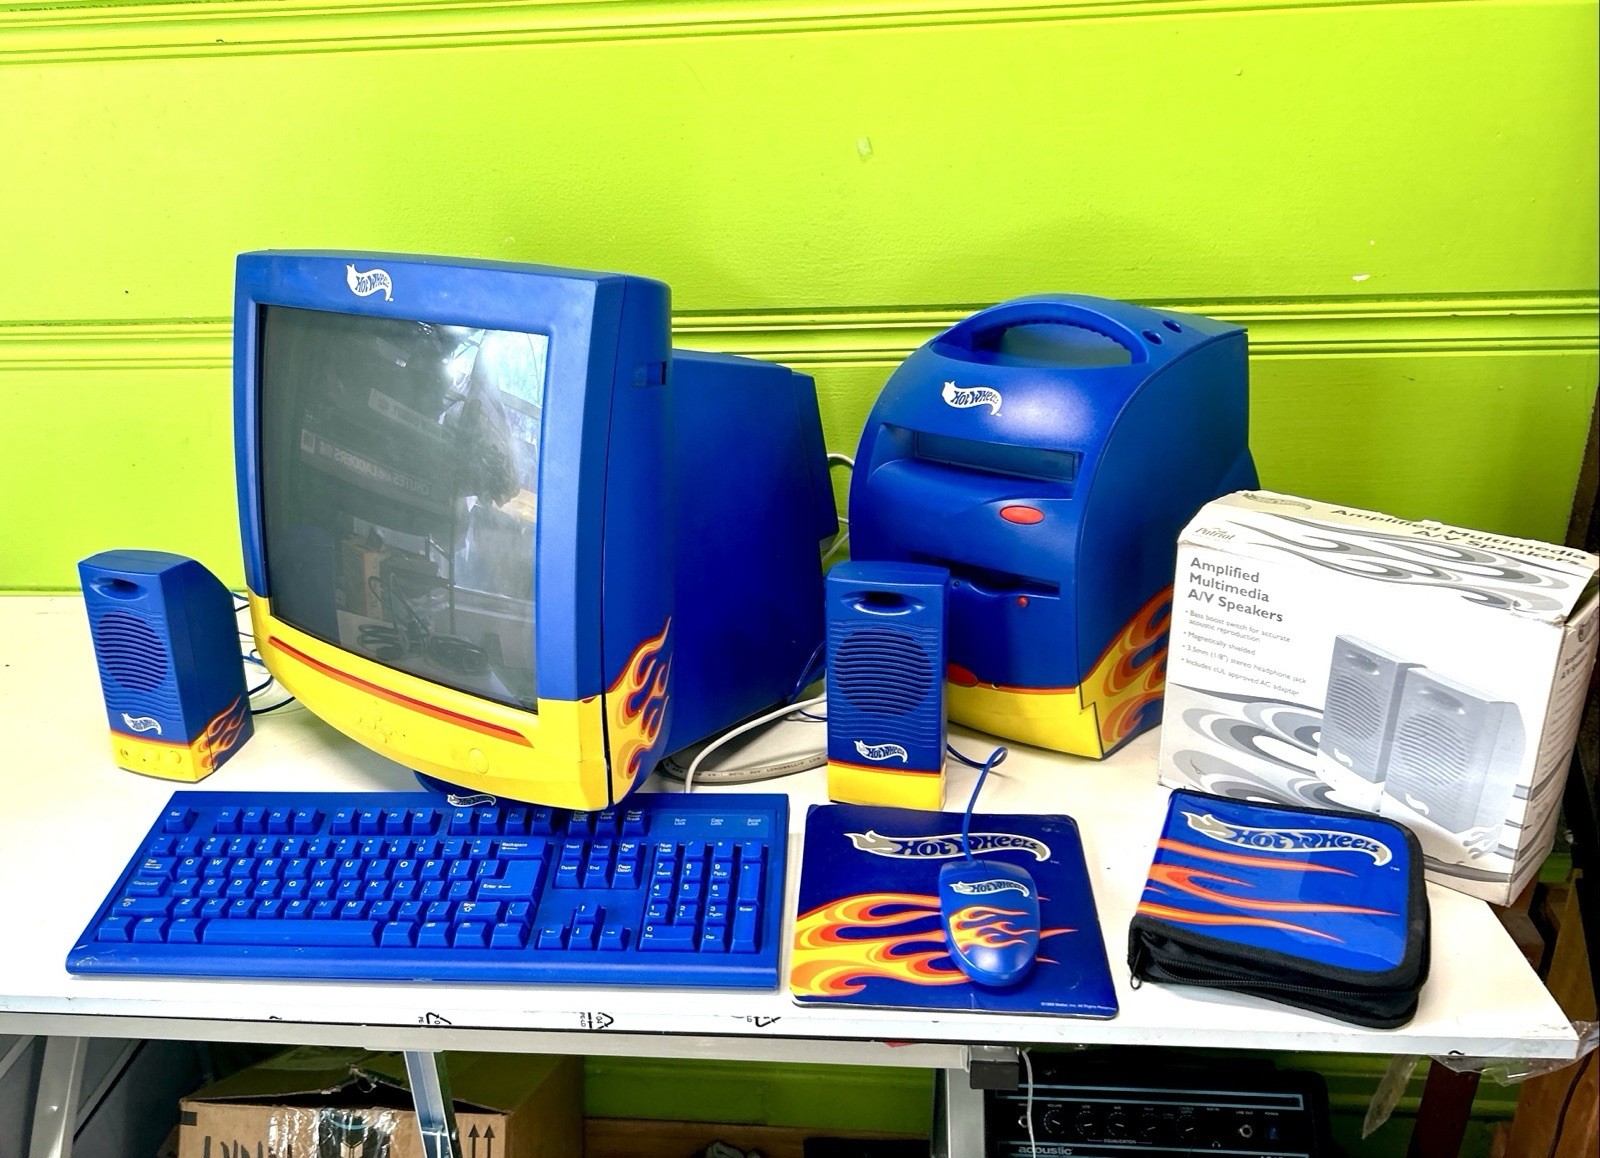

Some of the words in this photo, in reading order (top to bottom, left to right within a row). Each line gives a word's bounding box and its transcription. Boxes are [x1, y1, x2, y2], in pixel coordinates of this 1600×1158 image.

[1194, 527, 1236, 541] Patriot
[1330, 509, 1441, 532] Amplified
[1448, 529, 1587, 561] Multimedia
[1413, 530, 1460, 541] A/V
[1466, 539, 1581, 565] Speakers
[1190, 557, 1260, 583] Amplified
[1189, 572, 1270, 602] Multimedia
[1187, 588, 1214, 604] A/V
[1218, 596, 1283, 622] Speakers
[1189, 619, 1215, 631] acoustic
[1217, 627, 1260, 643] reproduction
[1190, 609, 1204, 619] Bass
[1205, 614, 1225, 625] boost
[1226, 621, 1248, 631] switch
[1249, 626, 1259, 634] for
[1261, 630, 1291, 643] accurate
[1188, 631, 1227, 649] Magnetically
[1228, 644, 1256, 656] shielded
[1185, 658, 1212, 671] Includes
[1228, 671, 1259, 685] approved
[1260, 679, 1271, 688] AC
[1187, 644, 1209, 656] 3.5mm
[1230, 658, 1252, 669] stereo
[1253, 664, 1291, 680] headphone
[1292, 675, 1307, 684] jack
[1018, 1147, 1072, 1155] acoustic
